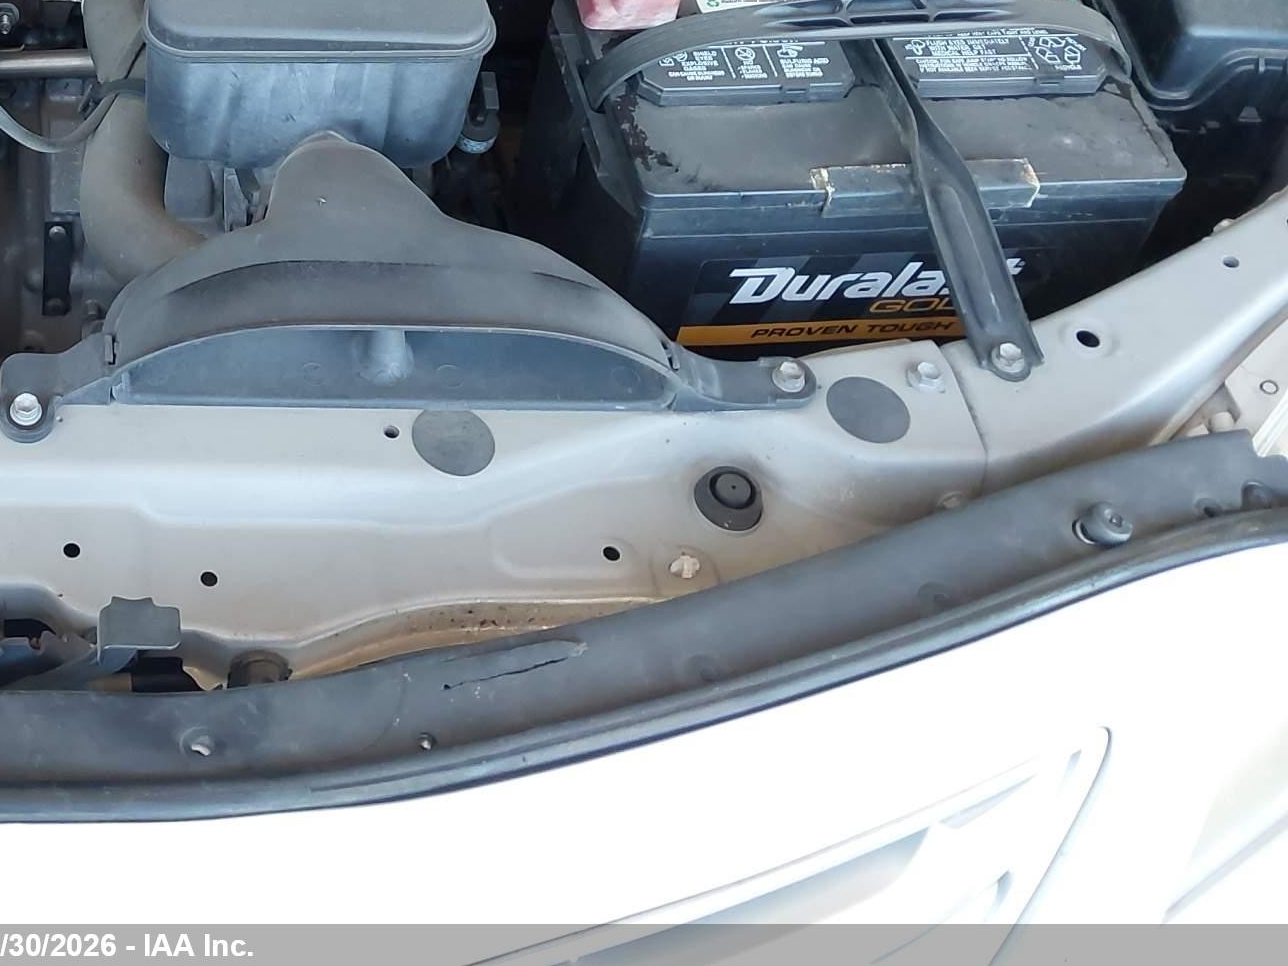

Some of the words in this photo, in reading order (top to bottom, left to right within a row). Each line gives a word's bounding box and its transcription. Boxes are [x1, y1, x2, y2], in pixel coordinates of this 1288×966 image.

[729, 260, 1023, 304] Durala
[870, 297, 955, 313] GOL
[751, 325, 856, 338] PROVEN
[864, 320, 954, 333] TOUGH
